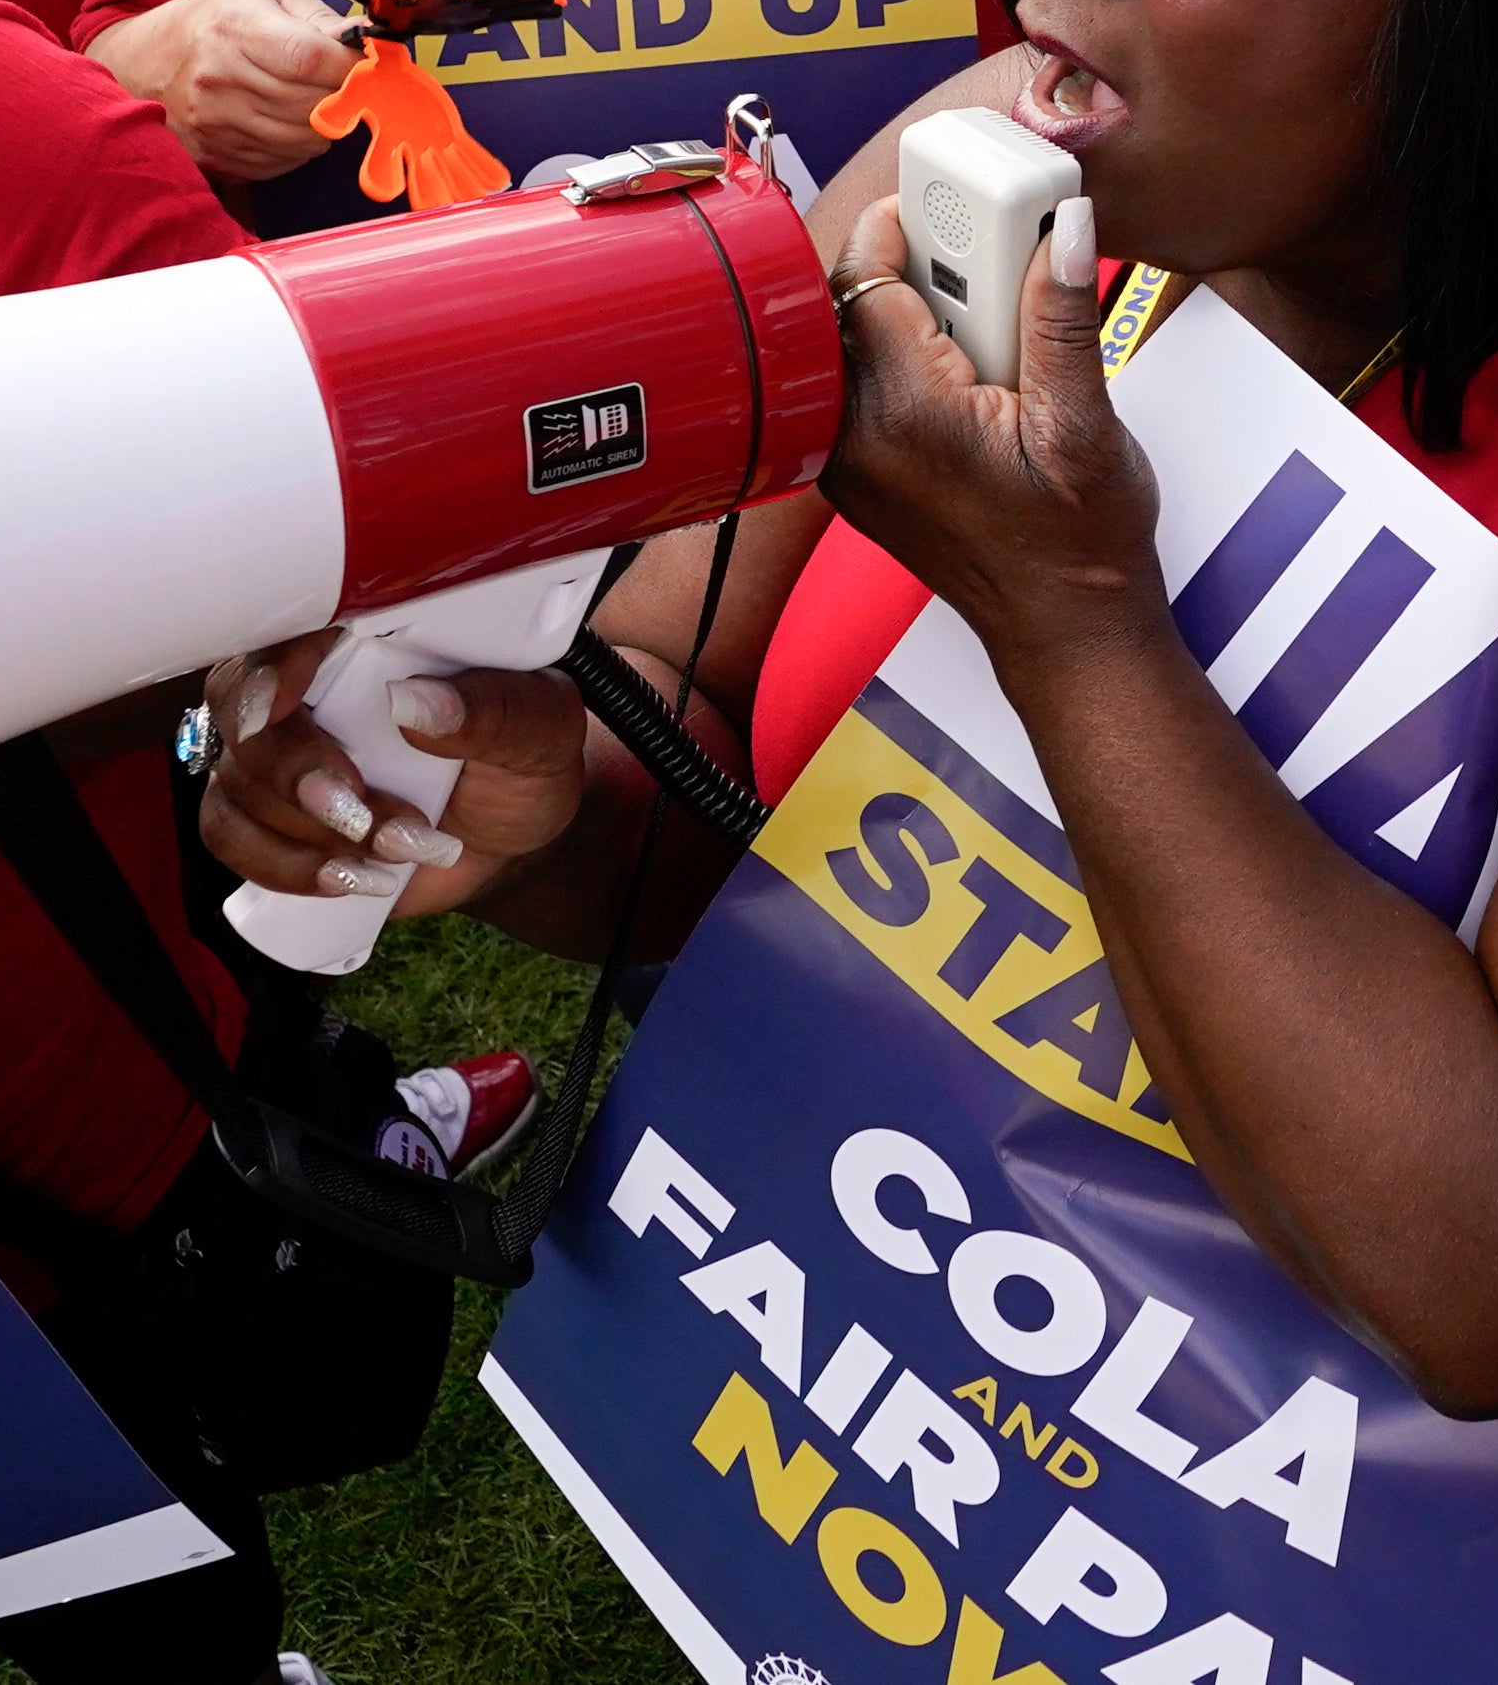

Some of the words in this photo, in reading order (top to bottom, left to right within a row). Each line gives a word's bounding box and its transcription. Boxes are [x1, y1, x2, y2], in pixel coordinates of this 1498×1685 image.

[1098, 263, 1167, 382] RONG
[540, 456, 603, 482] AUTOMATIC
[607, 447, 638, 465] SIREN
[607, 1125, 1001, 1550] FAIR
[830, 1127, 1360, 1567] COLA
[951, 1375, 1100, 1491] AND
[692, 1370, 1069, 1685] NOW
